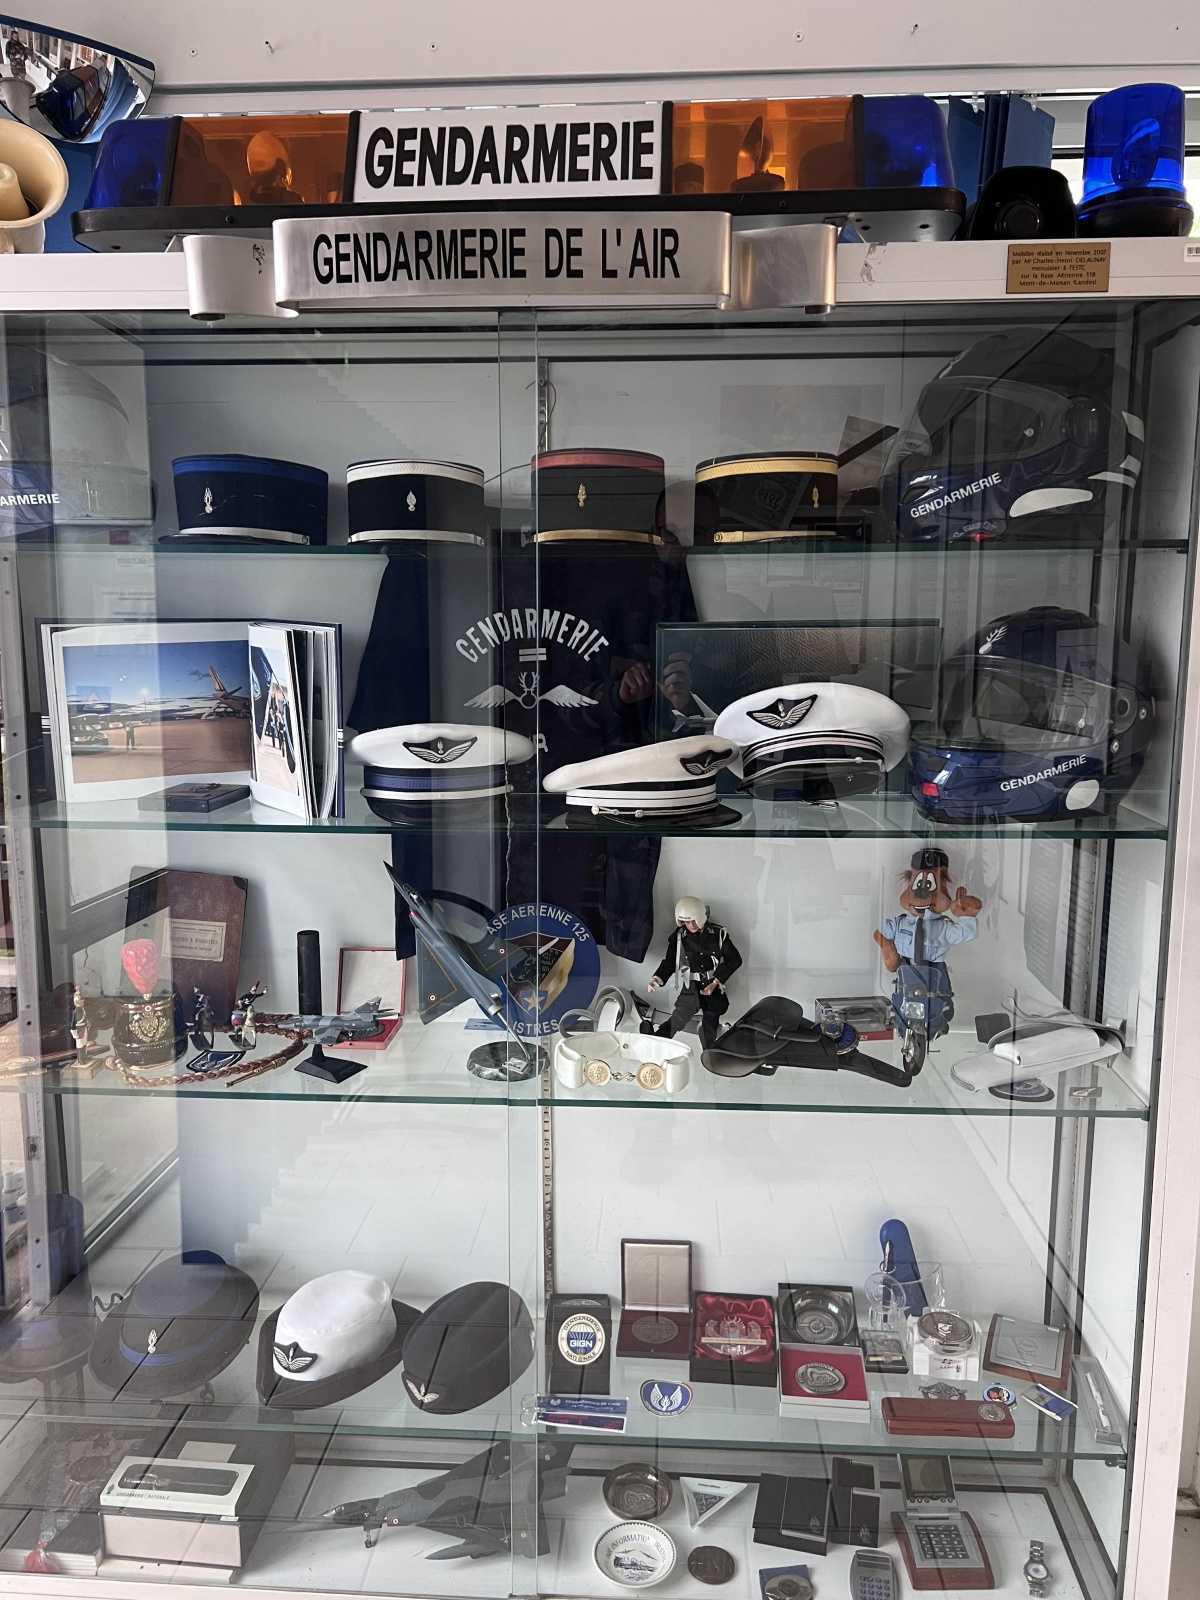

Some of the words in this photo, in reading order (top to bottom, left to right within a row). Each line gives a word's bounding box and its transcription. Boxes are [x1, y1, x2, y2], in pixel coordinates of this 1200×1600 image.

[364, 120, 654, 189] GENDARMERIE
[313, 227, 527, 285] GENDARMERIE
[544, 227, 584, 279] DE
[601, 227, 680, 279] L'AIR
[0, 493, 61, 506] ARMERIE
[910, 472, 1002, 518] GENDARMERIE
[455, 608, 610, 663] GENDARMERIE
[1000, 754, 1087, 791] GENDARMERIE
[486, 913, 511, 936] ASE
[570, 921, 590, 942] 125
[512, 1018, 560, 1035] ISTRES
[569, 1339, 593, 1348] GIGN
